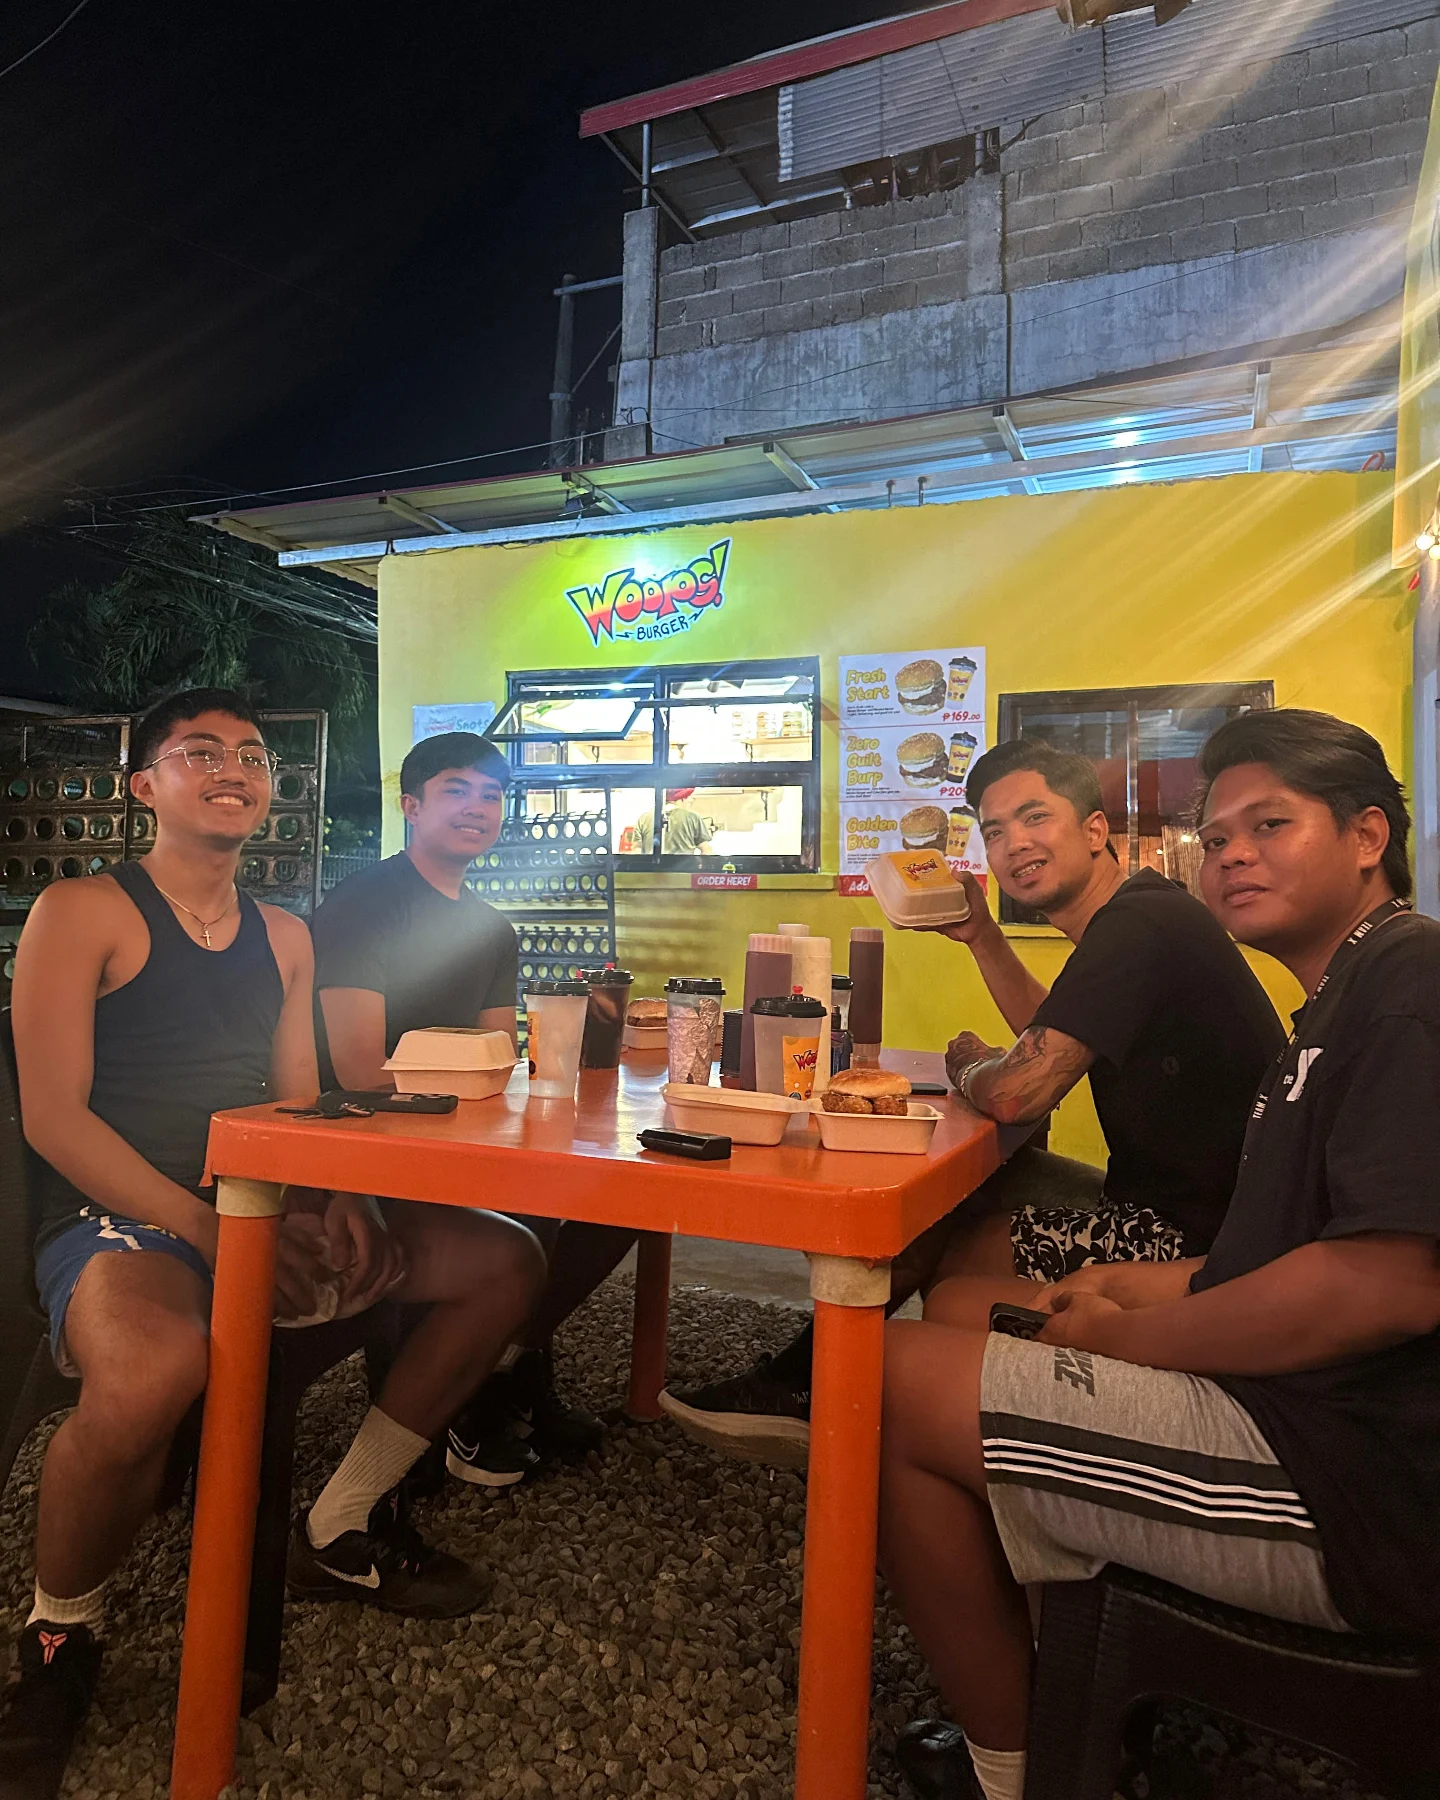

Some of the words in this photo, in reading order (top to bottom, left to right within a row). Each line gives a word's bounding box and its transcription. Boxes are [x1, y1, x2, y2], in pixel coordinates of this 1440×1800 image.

[637, 614, 689, 641] BURGER
[846, 667, 886, 686] Fresh
[847, 685, 889, 702] Start
[846, 735, 880, 752] Zero
[847, 752, 882, 768] Guilt
[847, 770, 883, 787] Burp
[846, 815, 897, 833] Golden
[847, 835, 879, 851] Bite
[697, 874, 725, 886] ORDER
[726, 873, 751, 886] HERE!
[849, 880, 870, 892] Add
[1353, 921, 1373, 939] TEAM
[1252, 1101, 1266, 1119] TEAM
